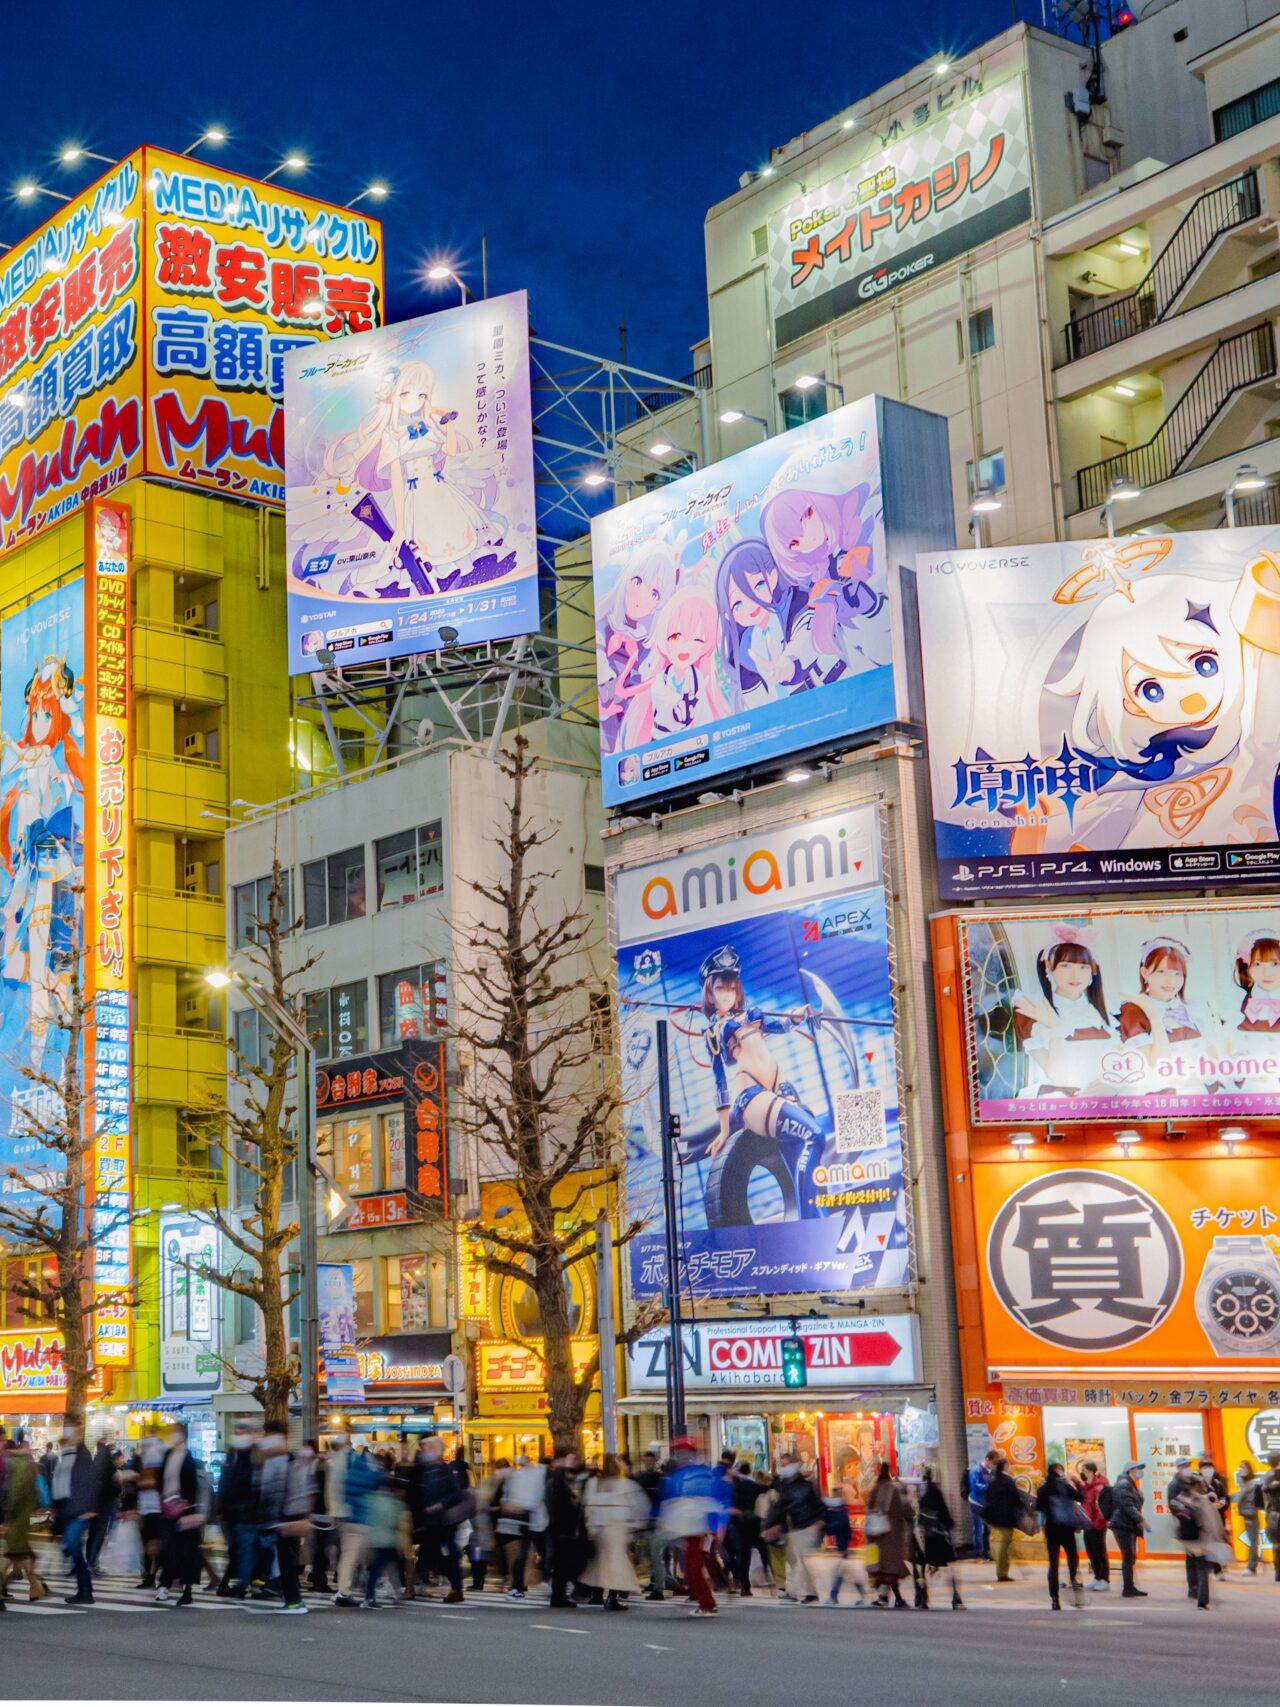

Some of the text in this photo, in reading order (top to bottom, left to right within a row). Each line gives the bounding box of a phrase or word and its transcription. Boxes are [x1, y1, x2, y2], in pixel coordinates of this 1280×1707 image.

[152, 169, 376, 264] MEDIAリサイクル
[790, 133, 1005, 289] メイドカジノ
[156, 223, 377, 333] 激安販売
[178, 460, 248, 490] ムーラン
[5, 511, 47, 550] ムーラン
[48, 495, 80, 523] AKIBA
[98, 560, 126, 574] あなたの
[308, 559, 329, 573] ミカ
[98, 577, 126, 595] DVD
[97, 593, 126, 610] ブルーレイ
[467, 598, 497, 615] 1/31
[97, 608, 126, 625] ゲーム
[309, 609, 337, 622] YOSTAR
[102, 624, 121, 640] CD
[97, 639, 126, 656] アイドル
[97, 654, 126, 670] アニメ
[98, 670, 125, 685] コミック
[99, 685, 125, 701] ホビー
[721, 722, 751, 738] YOSTAR
[964, 815, 1049, 830] Genshin
[1198, 855, 1216, 863] Store
[1244, 852, 1267, 861] Google
[1099, 857, 1163, 874] Windows
[642, 828, 849, 920] amiami
[822, 907, 872, 931] APEX
[97, 1026, 129, 1042] 5F 中古
[98, 1047, 127, 1062] DVD
[96, 1063, 129, 1079] 4F 中古
[96, 1100, 129, 1116] 3F 中古
[99, 1158, 125, 1173] 買取
[814, 1160, 889, 1185] amiami
[1190, 1205, 1279, 1229] チケット
[1011, 1195, 1168, 1328] 質
[97, 1304, 127, 1319] ムーラン
[707, 1325, 747, 1335] Professional
[749, 1323, 777, 1335] Support
[837, 1318, 885, 1330] MANGA-ZIN
[809, 1336, 852, 1366] ZIN
[384, 1363, 442, 1379] YOSHINOYA
